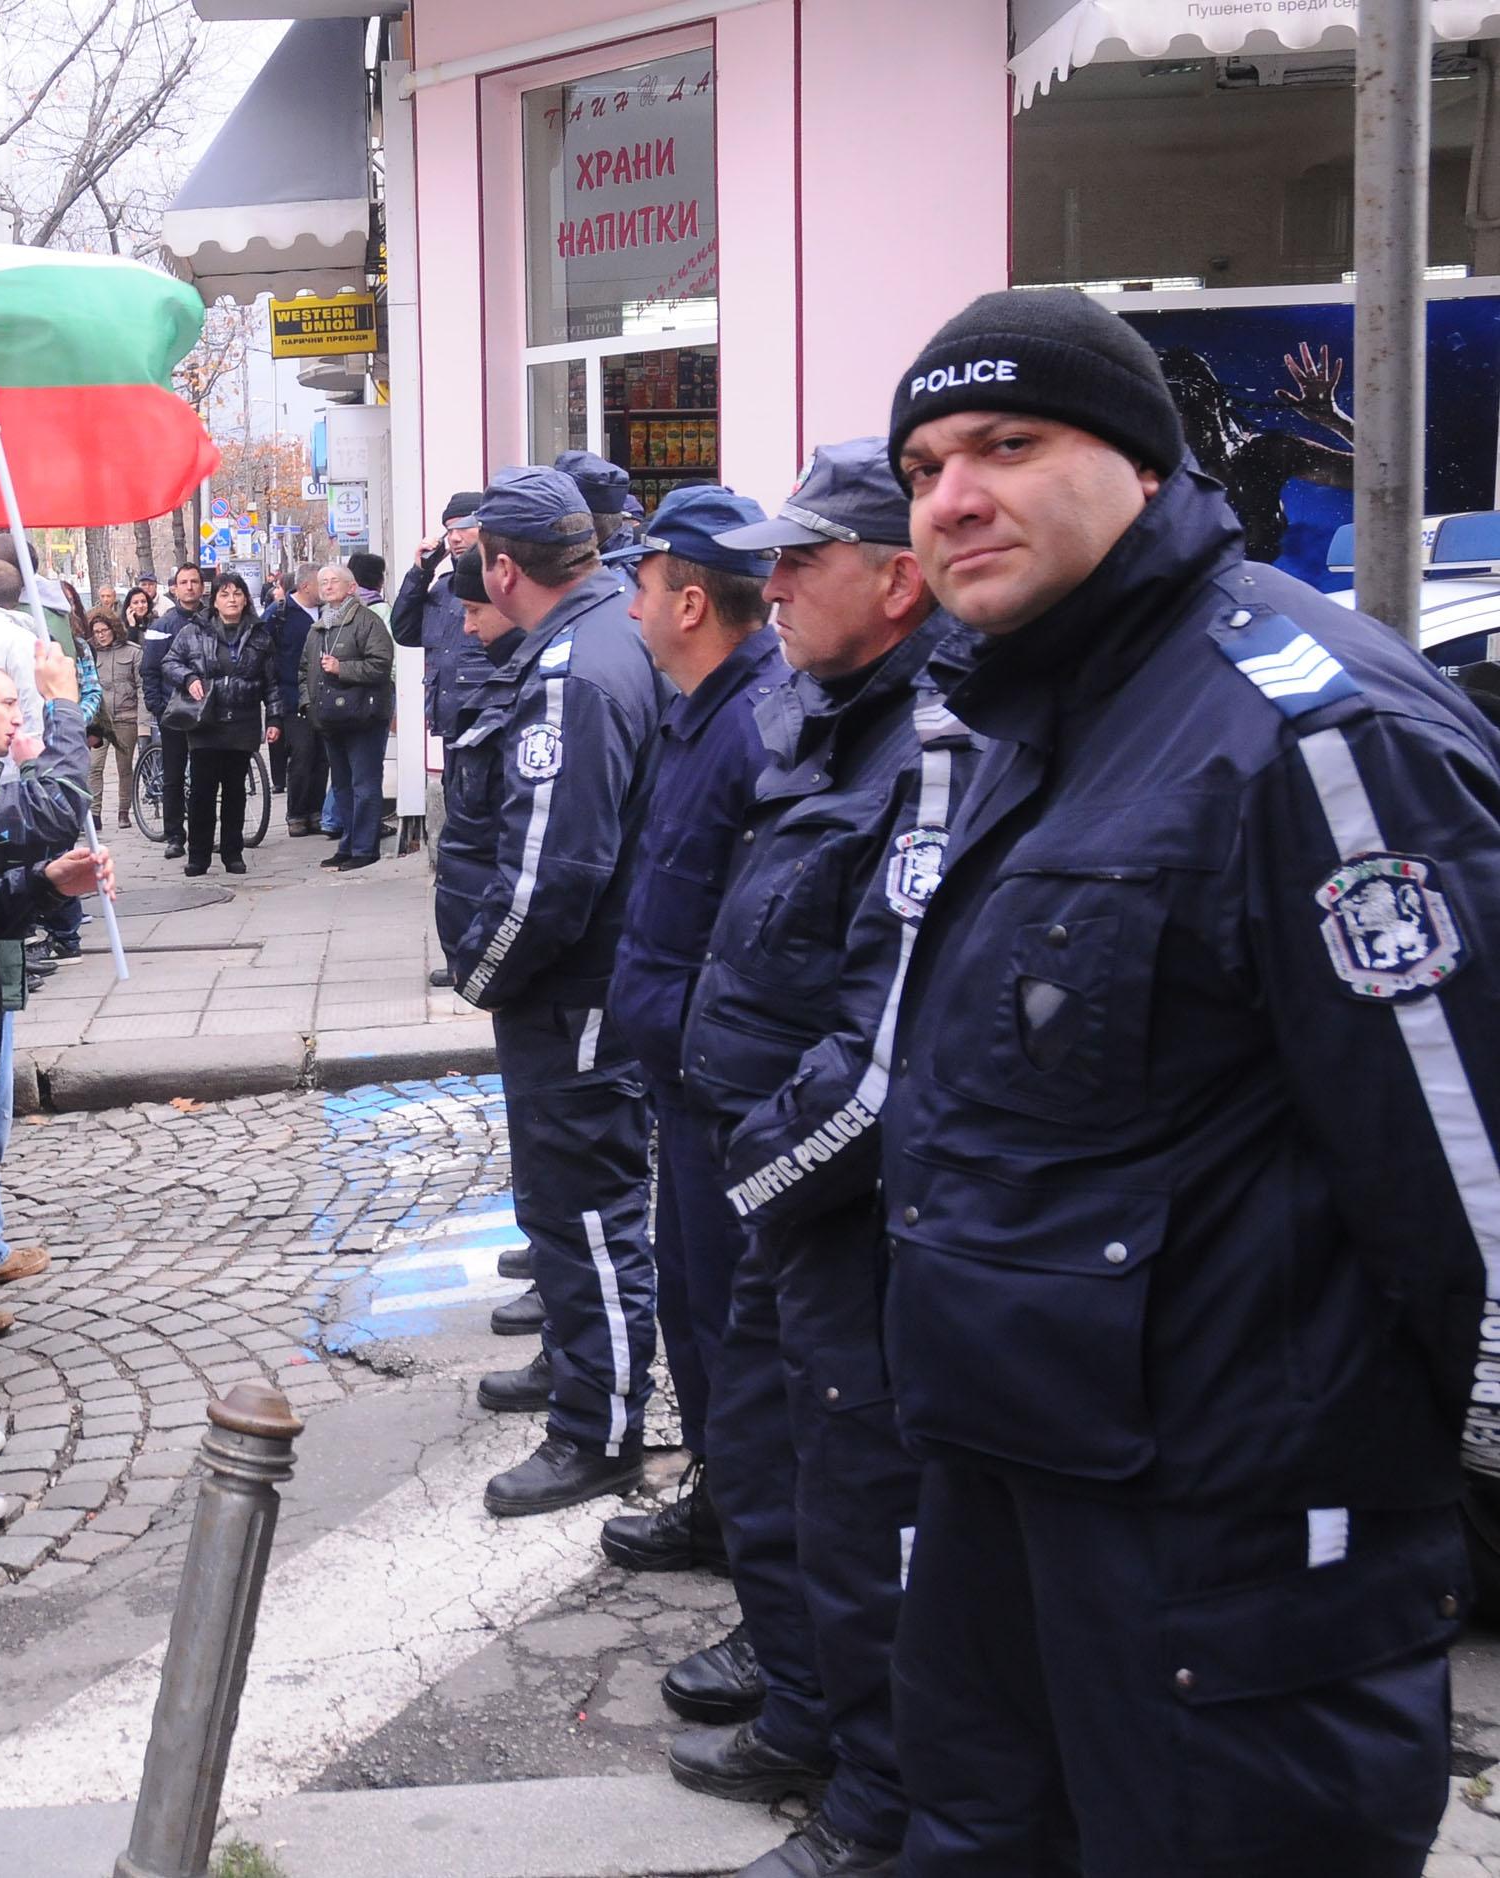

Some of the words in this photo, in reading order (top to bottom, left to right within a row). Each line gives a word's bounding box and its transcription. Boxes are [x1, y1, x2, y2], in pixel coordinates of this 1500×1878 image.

[1188, 1, 1272, 17] Пушенето
[1278, 0, 1328, 13] вреди
[576, 136, 676, 191] ХРАНИ
[557, 199, 700, 258] НАПИТКИ
[276, 306, 355, 322] WESTERN
[302, 318, 356, 332] UNION
[281, 336, 324, 345] ПАРИЧНИ
[326, 334, 368, 343] ПРЕВОДИ
[910, 359, 1018, 400] POLICE
[462, 960, 496, 1004] TRAFFIC
[483, 916, 522, 967] POLICE
[725, 1155, 804, 1217] TRAFFIC
[792, 1098, 876, 1173] POLICE
